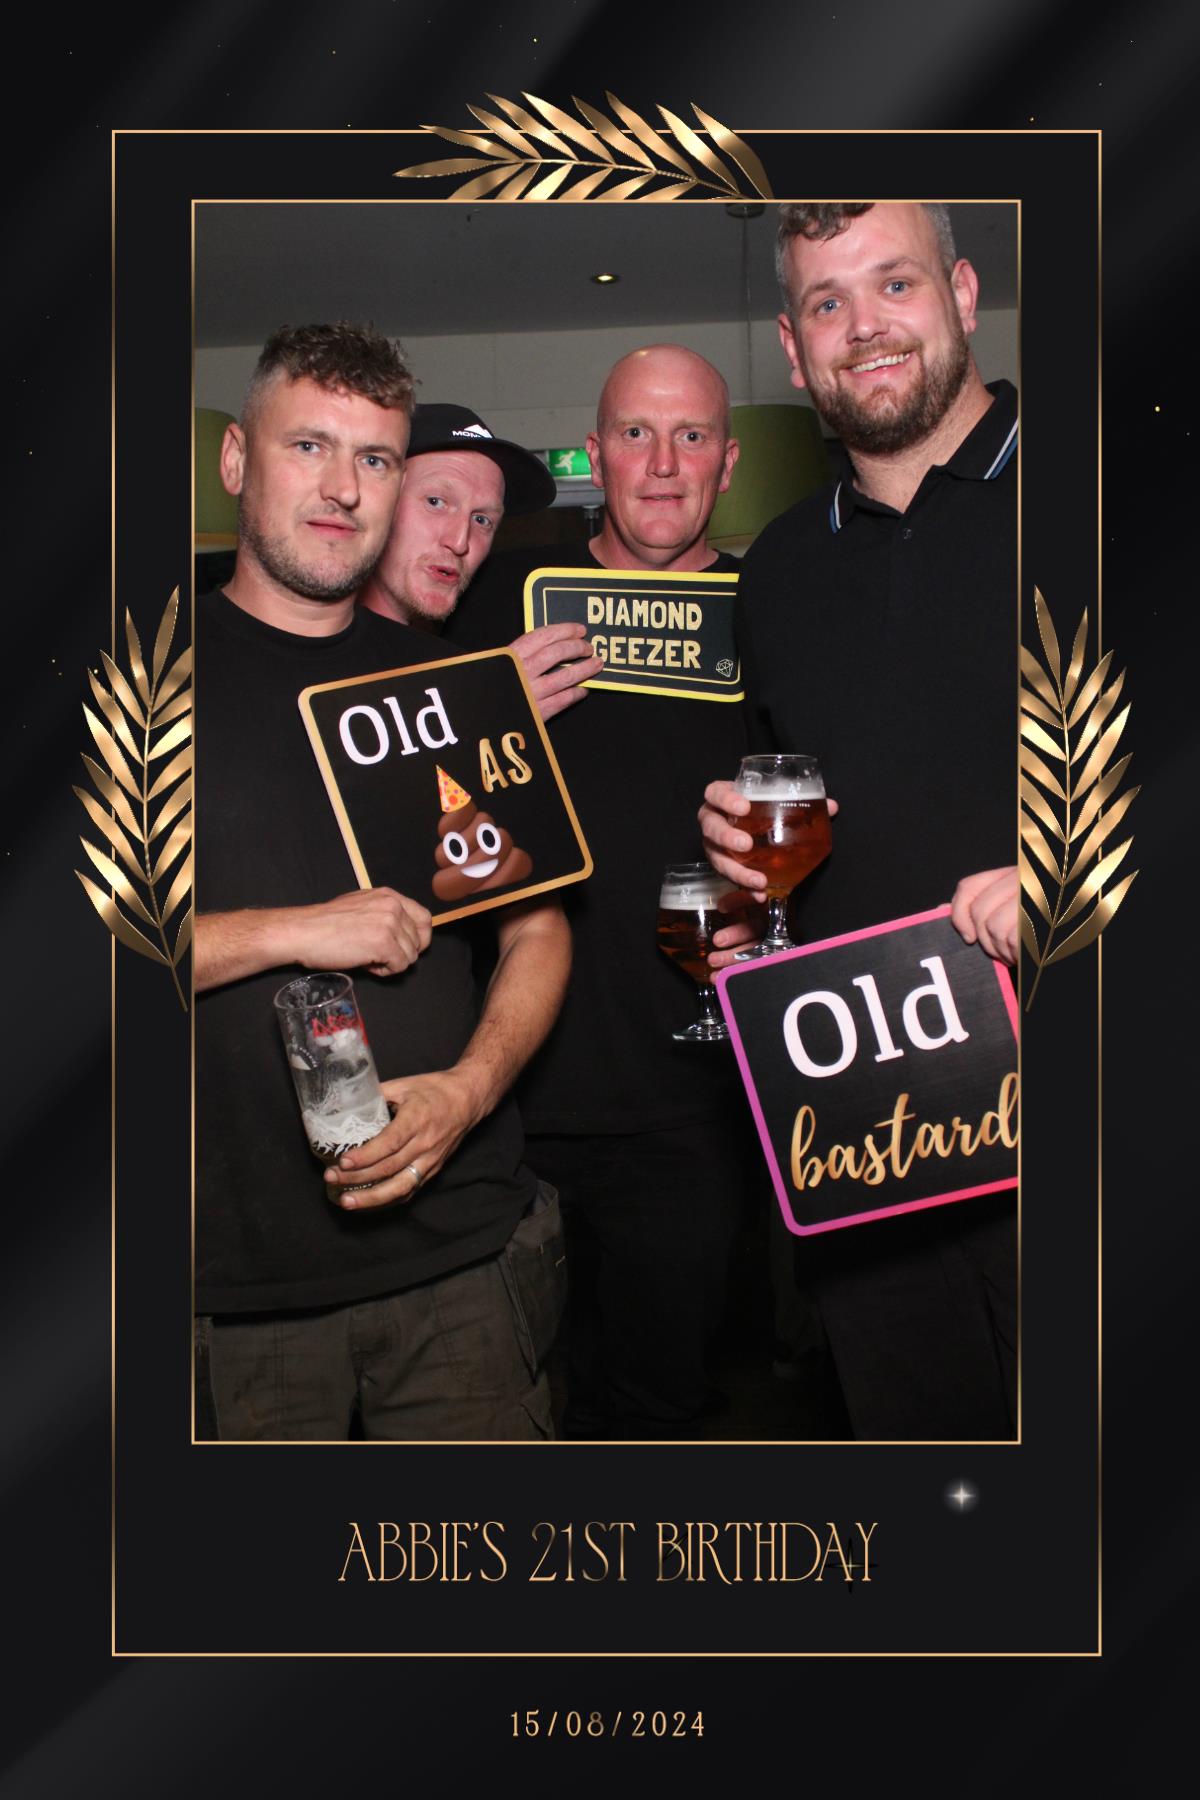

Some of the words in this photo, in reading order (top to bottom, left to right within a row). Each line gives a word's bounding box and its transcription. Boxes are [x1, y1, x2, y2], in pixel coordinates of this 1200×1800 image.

[587, 596, 703, 631] DIAMOND
[590, 635, 701, 669] GEEZER
[338, 687, 459, 765] Old
[479, 731, 533, 793] AS
[783, 955, 970, 1078] Old
[790, 1072, 1020, 1191] bastard
